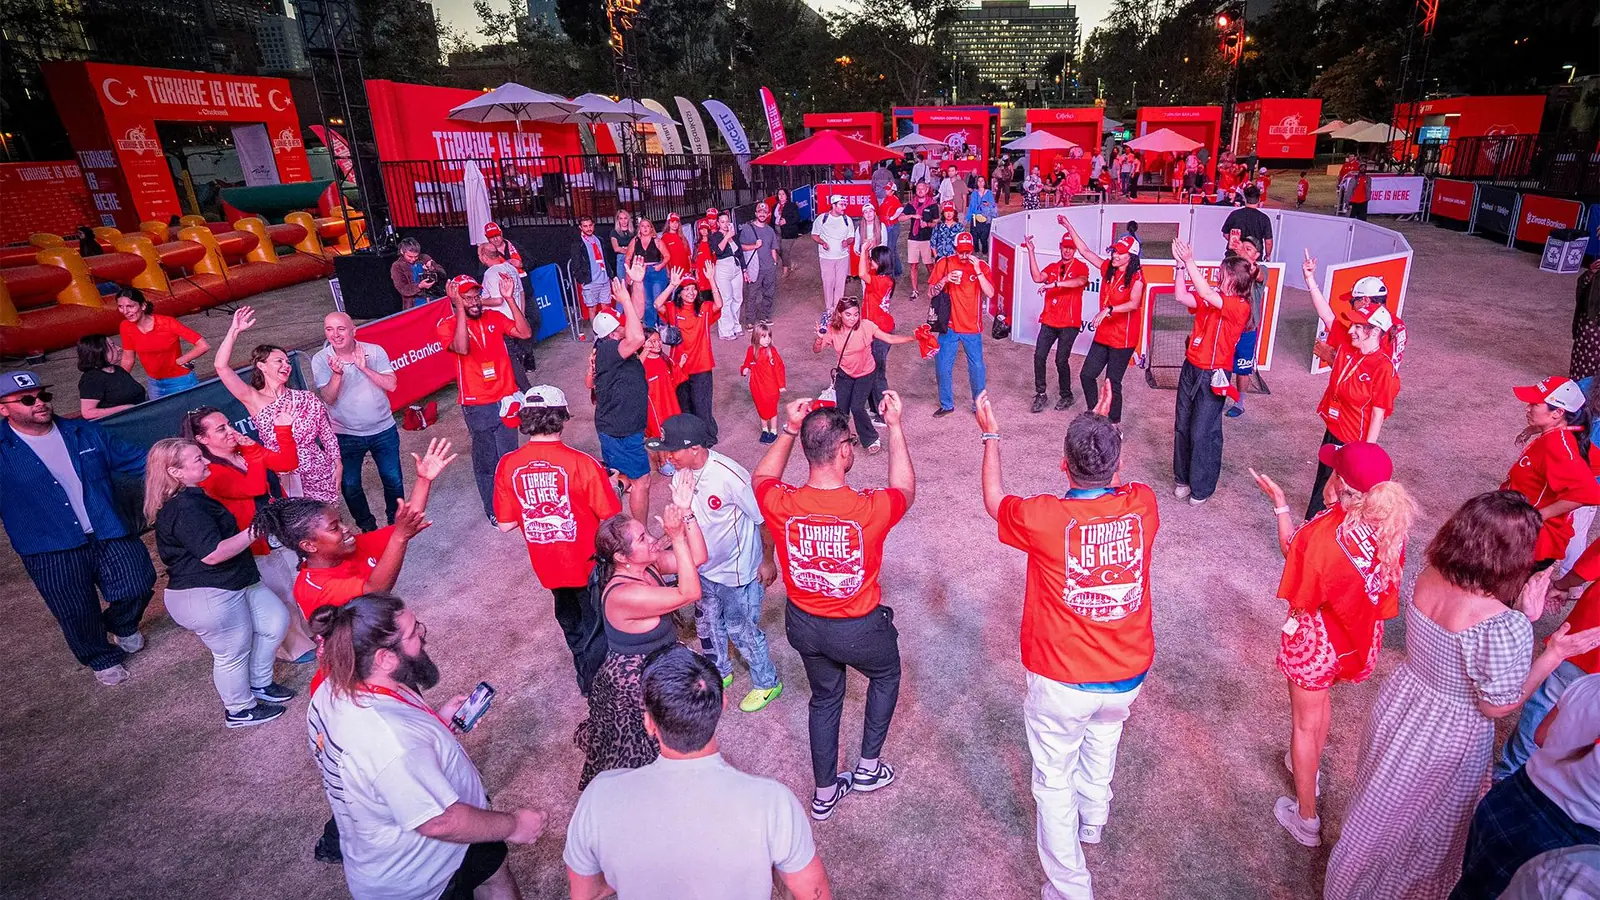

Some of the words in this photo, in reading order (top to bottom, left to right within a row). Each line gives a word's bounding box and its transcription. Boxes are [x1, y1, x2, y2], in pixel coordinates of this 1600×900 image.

[143, 76, 209, 106] TÜRKİYE
[209, 80, 227, 106] IS
[226, 82, 263, 108] HERE
[201, 108, 229, 116] Chobani
[432, 131, 497, 171] TÜRKİYE
[497, 131, 512, 167] IS
[513, 132, 546, 167] HERE
[53, 165, 64, 179] IS
[85, 172, 99, 190] IS
[92, 193, 122, 211] HERE
[856, 194, 872, 205] HERE
[1392, 190, 1410, 201] HERE
[390, 353, 410, 373] aat
[525, 489, 538, 505] IS
[537, 488, 560, 504] HERE
[797, 523, 851, 542] TÜRKİYE
[1079, 518, 1134, 545] TÜRKİYE
[799, 540, 814, 556] IS
[816, 542, 851, 559] HERE
[1080, 543, 1096, 568] IS
[1099, 538, 1135, 566] HERE
[1357, 539, 1376, 562] IS
